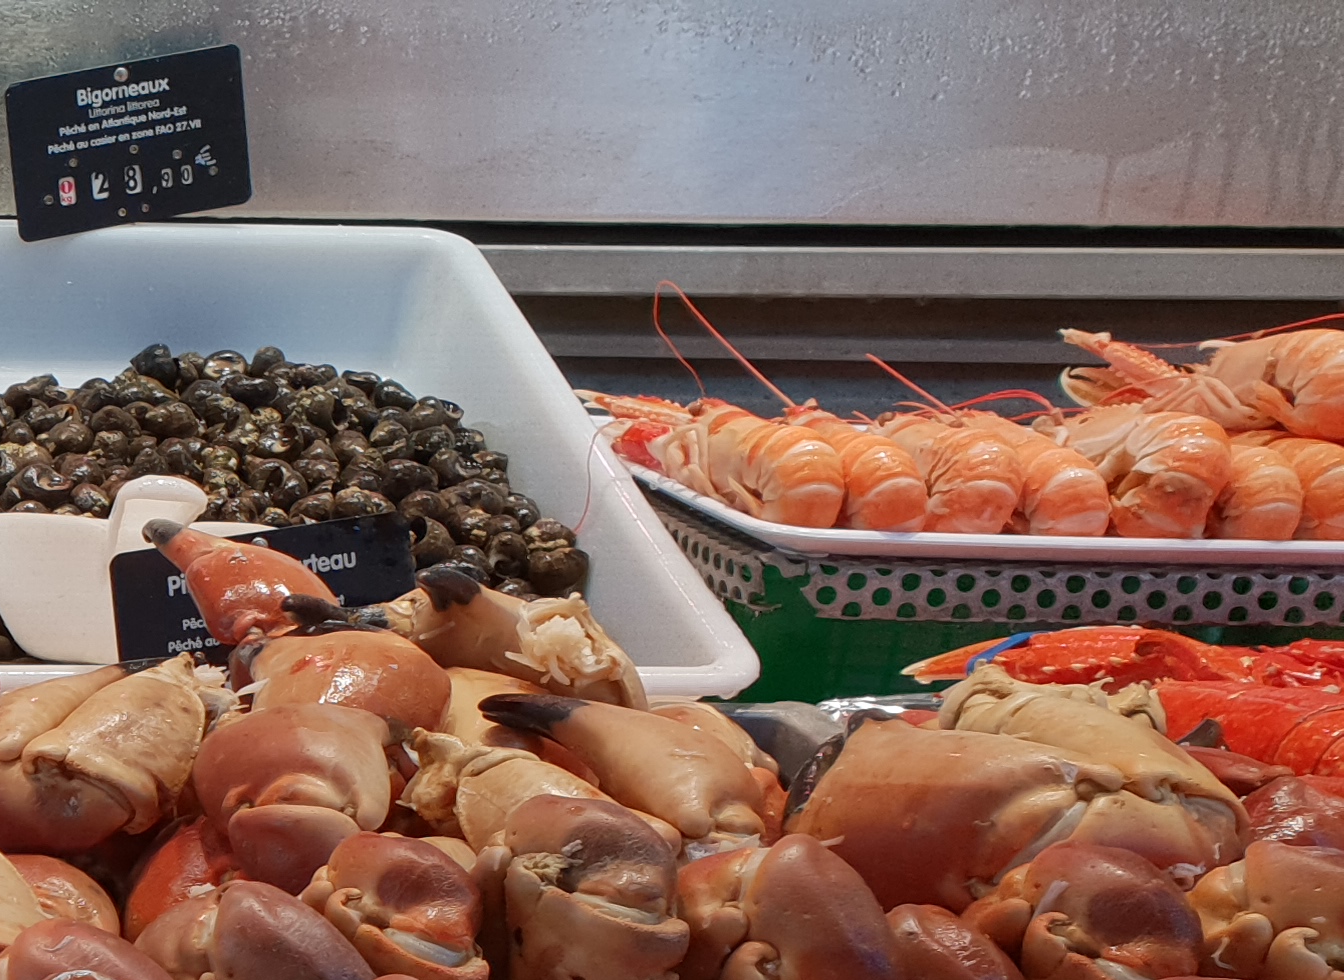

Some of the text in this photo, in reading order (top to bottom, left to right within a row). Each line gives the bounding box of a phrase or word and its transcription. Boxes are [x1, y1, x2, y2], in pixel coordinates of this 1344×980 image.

[76, 77, 170, 108] Bigorneaux
[88, 123, 100, 131] en
[101, 113, 147, 129] Atlantique
[148, 106, 186, 121] Nord-Est
[76, 140, 89, 149] au
[91, 134, 116, 147] casier
[118, 133, 130, 142] en
[132, 128, 154, 140] zone
[155, 124, 174, 135] FAO
[176, 119, 201, 132] 27.VII
[168, 638, 202, 653] Pêché
